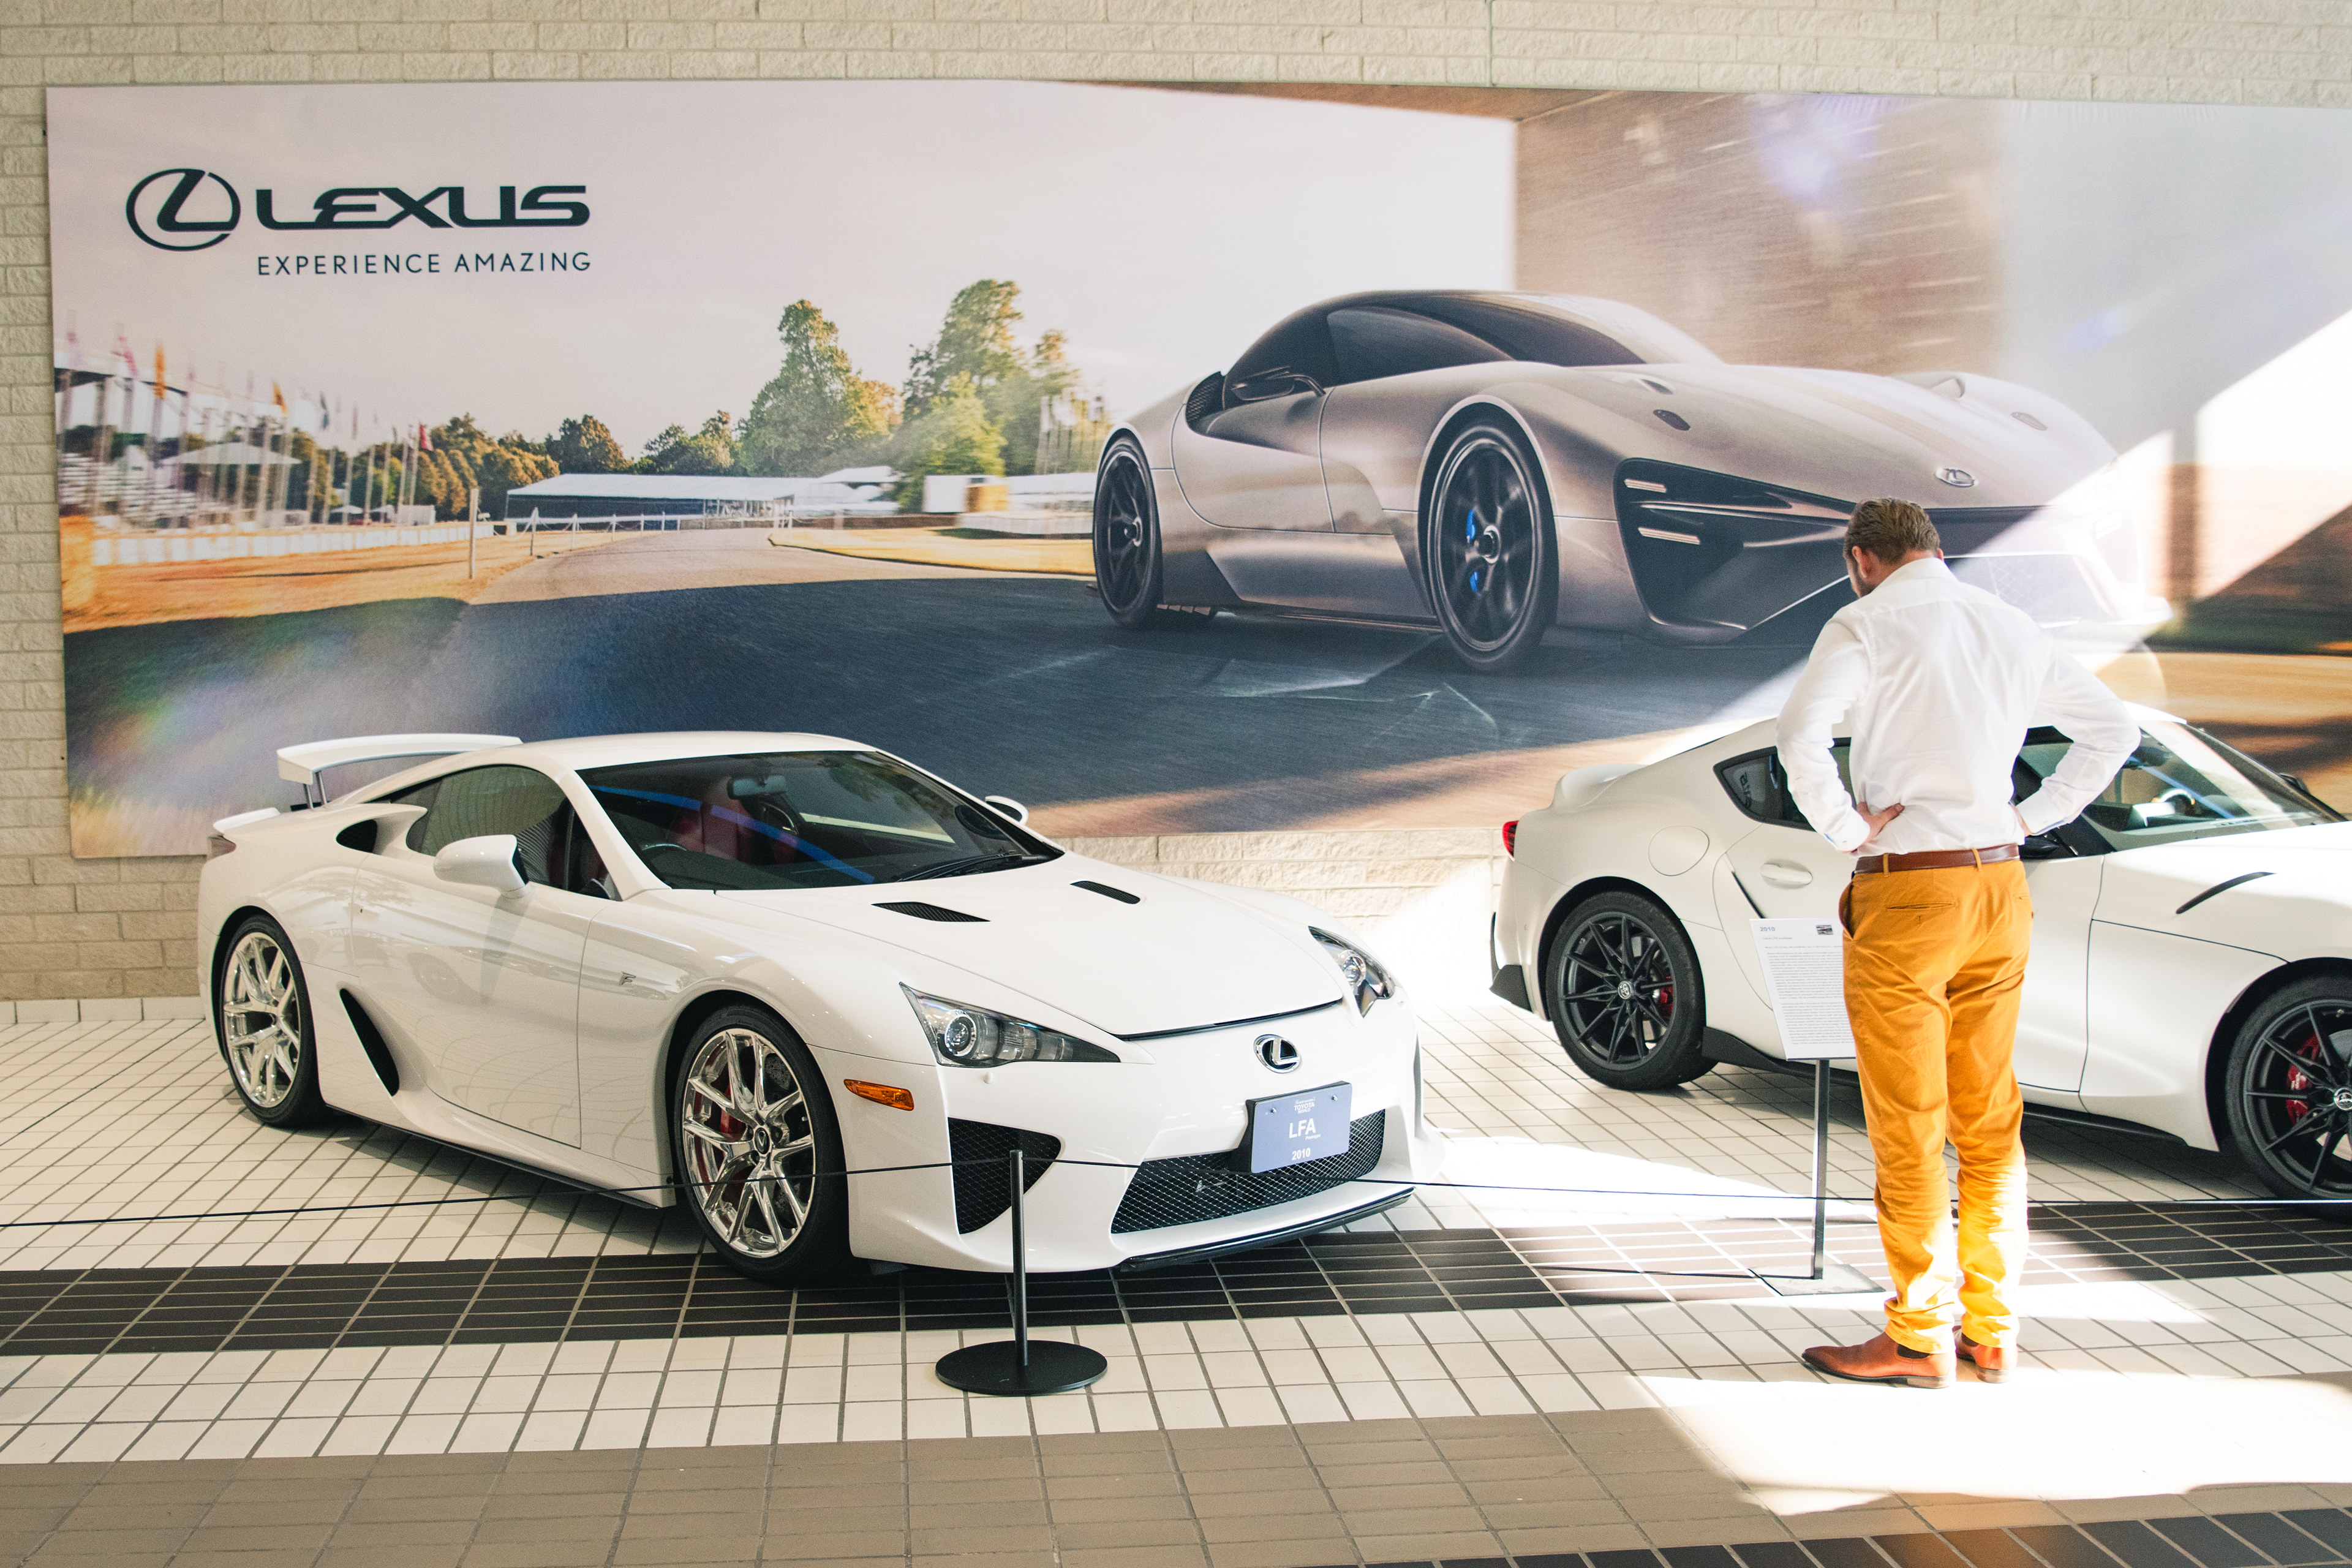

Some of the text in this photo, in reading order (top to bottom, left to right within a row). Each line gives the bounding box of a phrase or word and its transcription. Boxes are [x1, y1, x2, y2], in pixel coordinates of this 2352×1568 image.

[255, 185, 590, 230] LEXUS
[258, 252, 590, 276] EXPERIENCE AMAZING
[1294, 1102, 1315, 1111] TOYOTA
[1289, 1118, 1316, 1139] LFA
[1291, 1147, 1311, 1161] 2010
